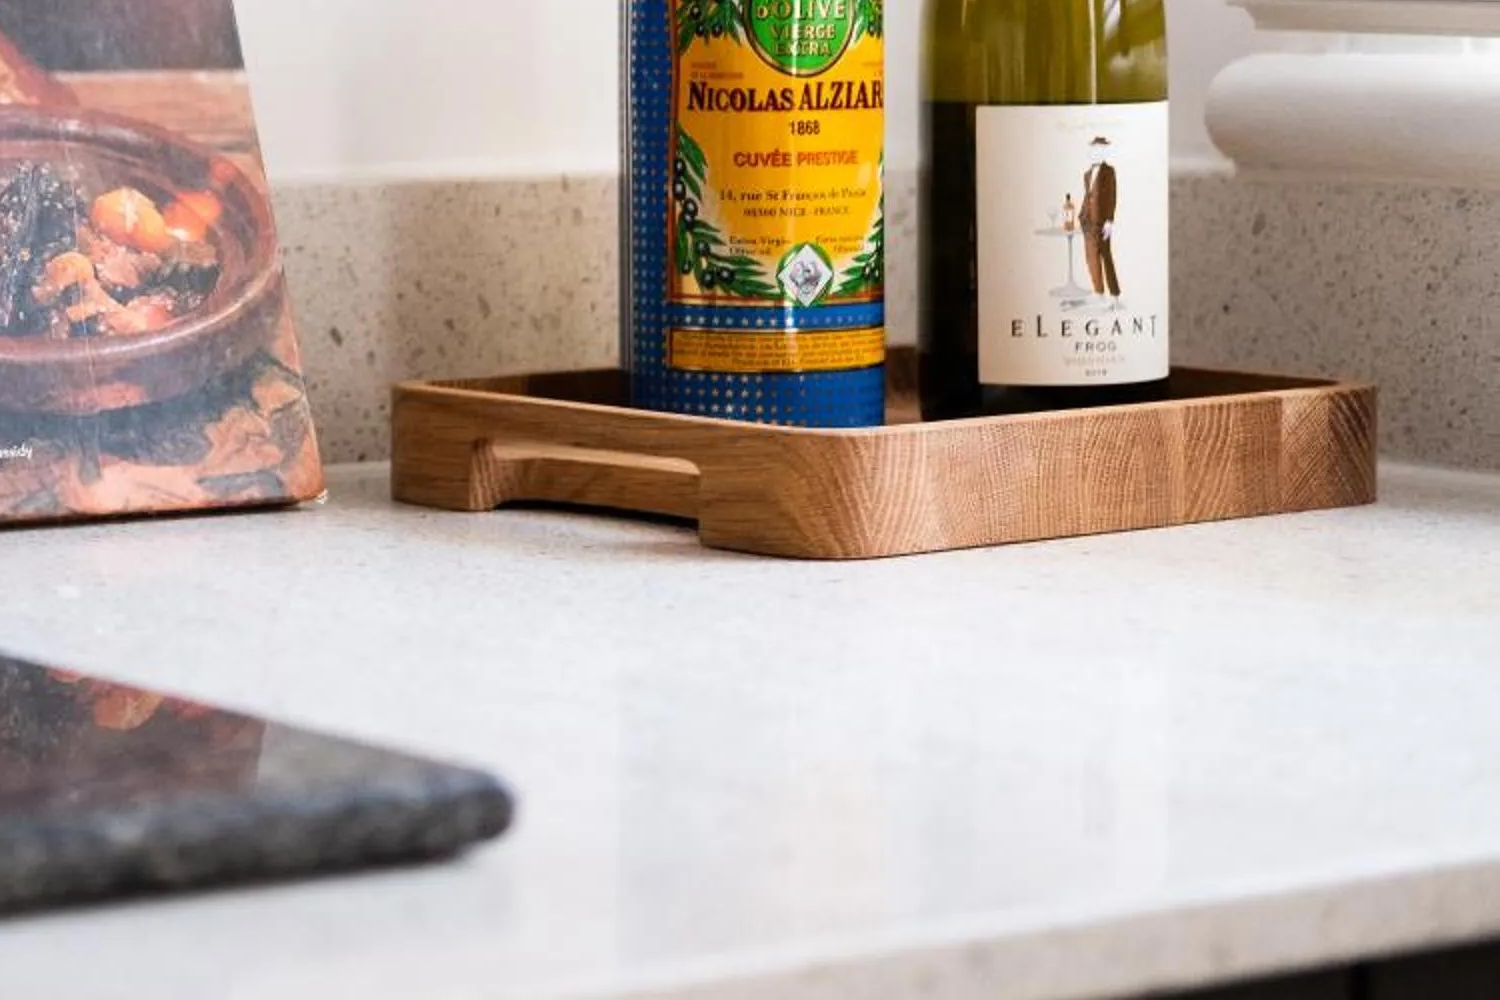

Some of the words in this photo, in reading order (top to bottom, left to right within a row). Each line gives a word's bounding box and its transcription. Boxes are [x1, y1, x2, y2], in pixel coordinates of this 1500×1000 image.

[771, 23, 835, 39] VIERGE
[798, 80, 884, 111] ALZIAR
[789, 120, 820, 135] 1868
[733, 148, 792, 167] CUVÉE
[797, 150, 858, 167] PRESTIGE
[1011, 313, 1157, 339] ELEGANT
[1074, 341, 1118, 353] FROG
